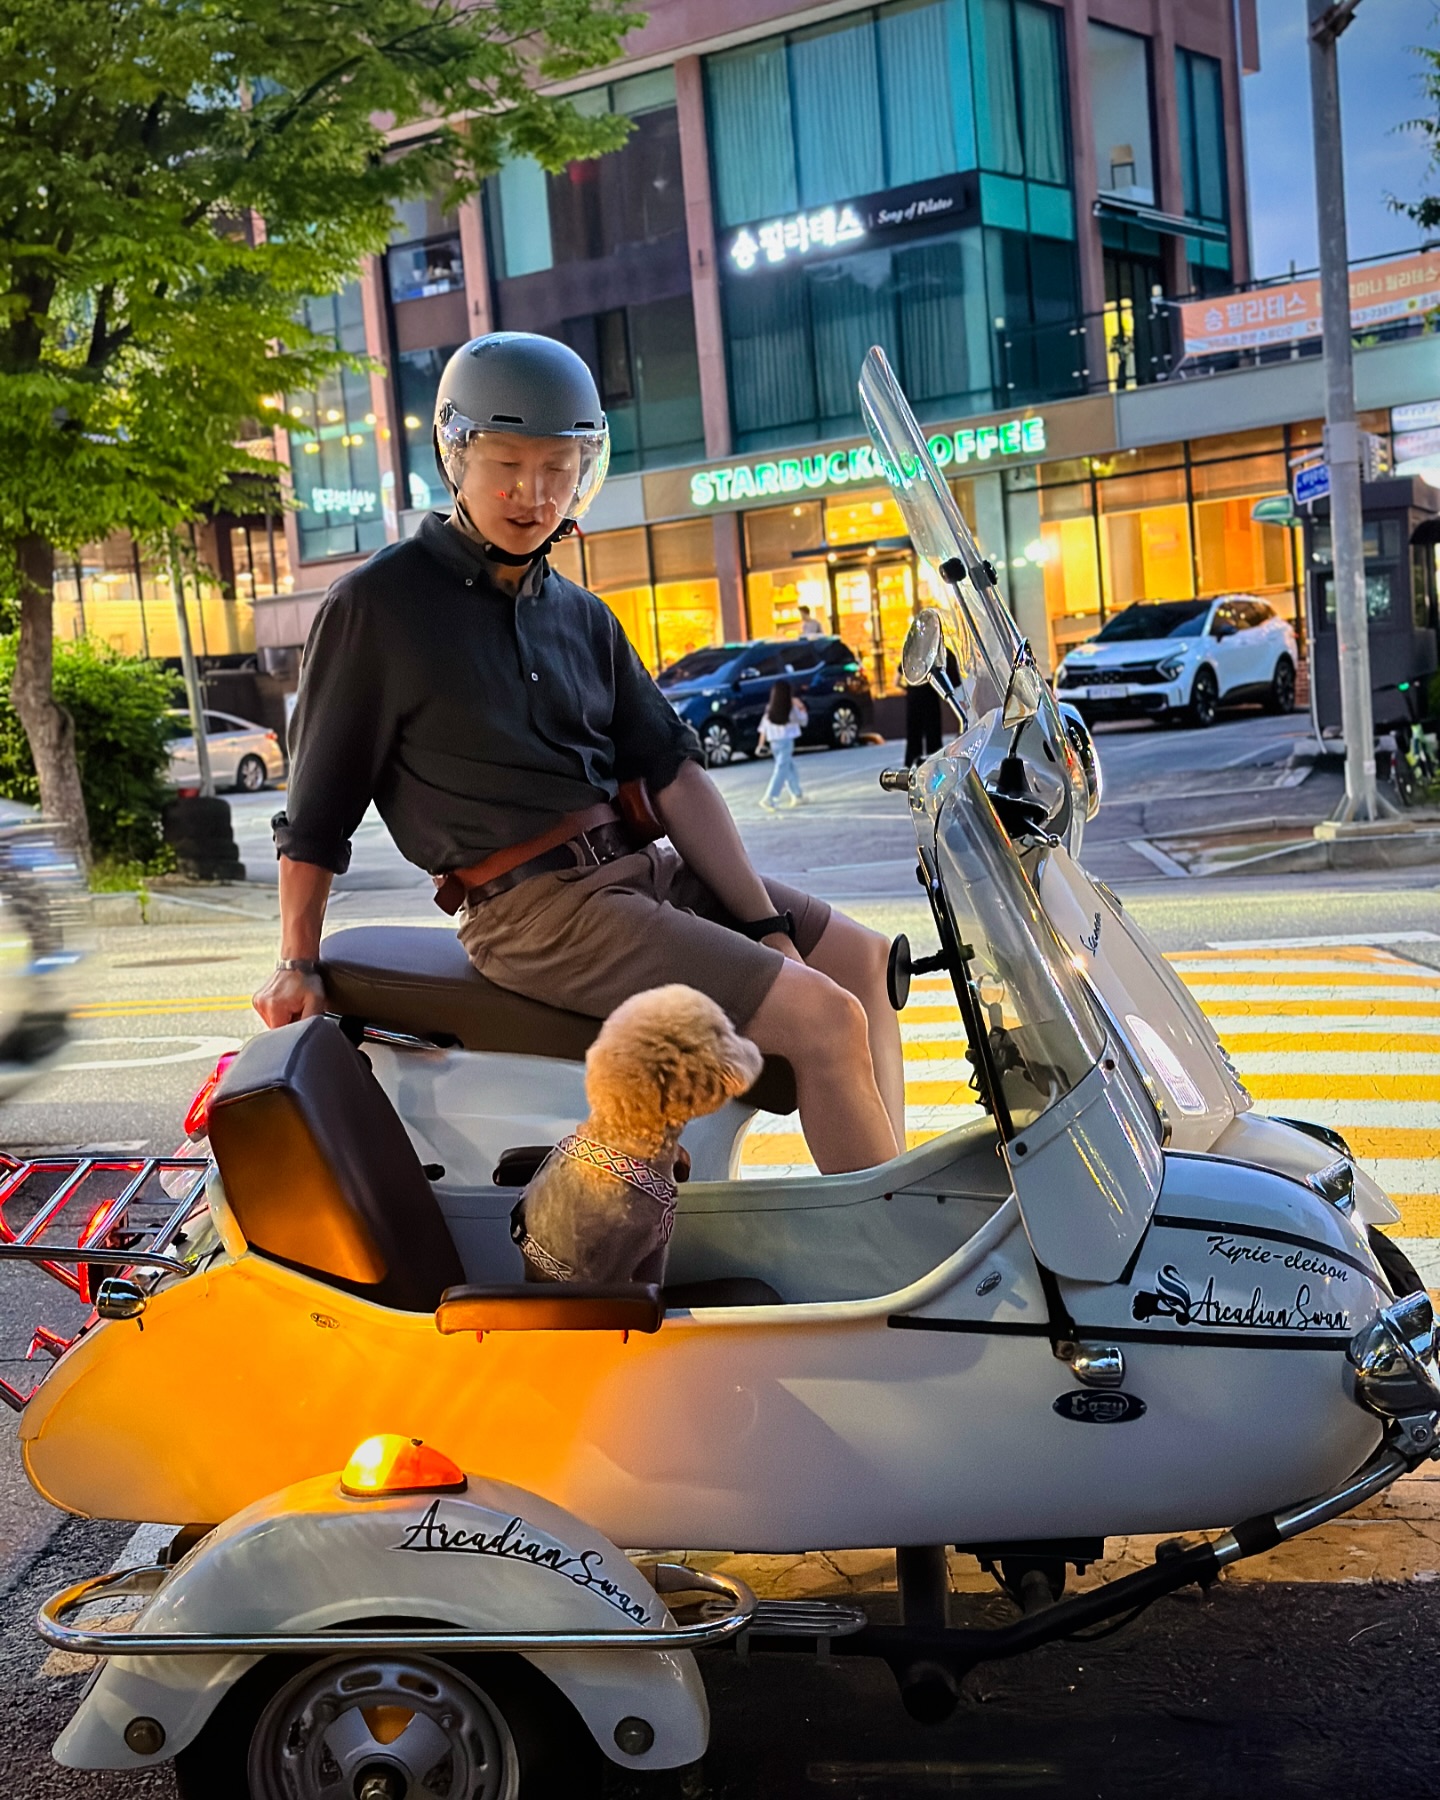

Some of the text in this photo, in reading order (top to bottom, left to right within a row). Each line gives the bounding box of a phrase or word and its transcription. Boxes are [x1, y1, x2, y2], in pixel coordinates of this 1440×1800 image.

[1206, 1235, 1350, 1283] Kyrie-eleison
[1190, 1277, 1351, 1331] Arcadian Swan
[401, 1499, 652, 1625] Arcadian Swan
